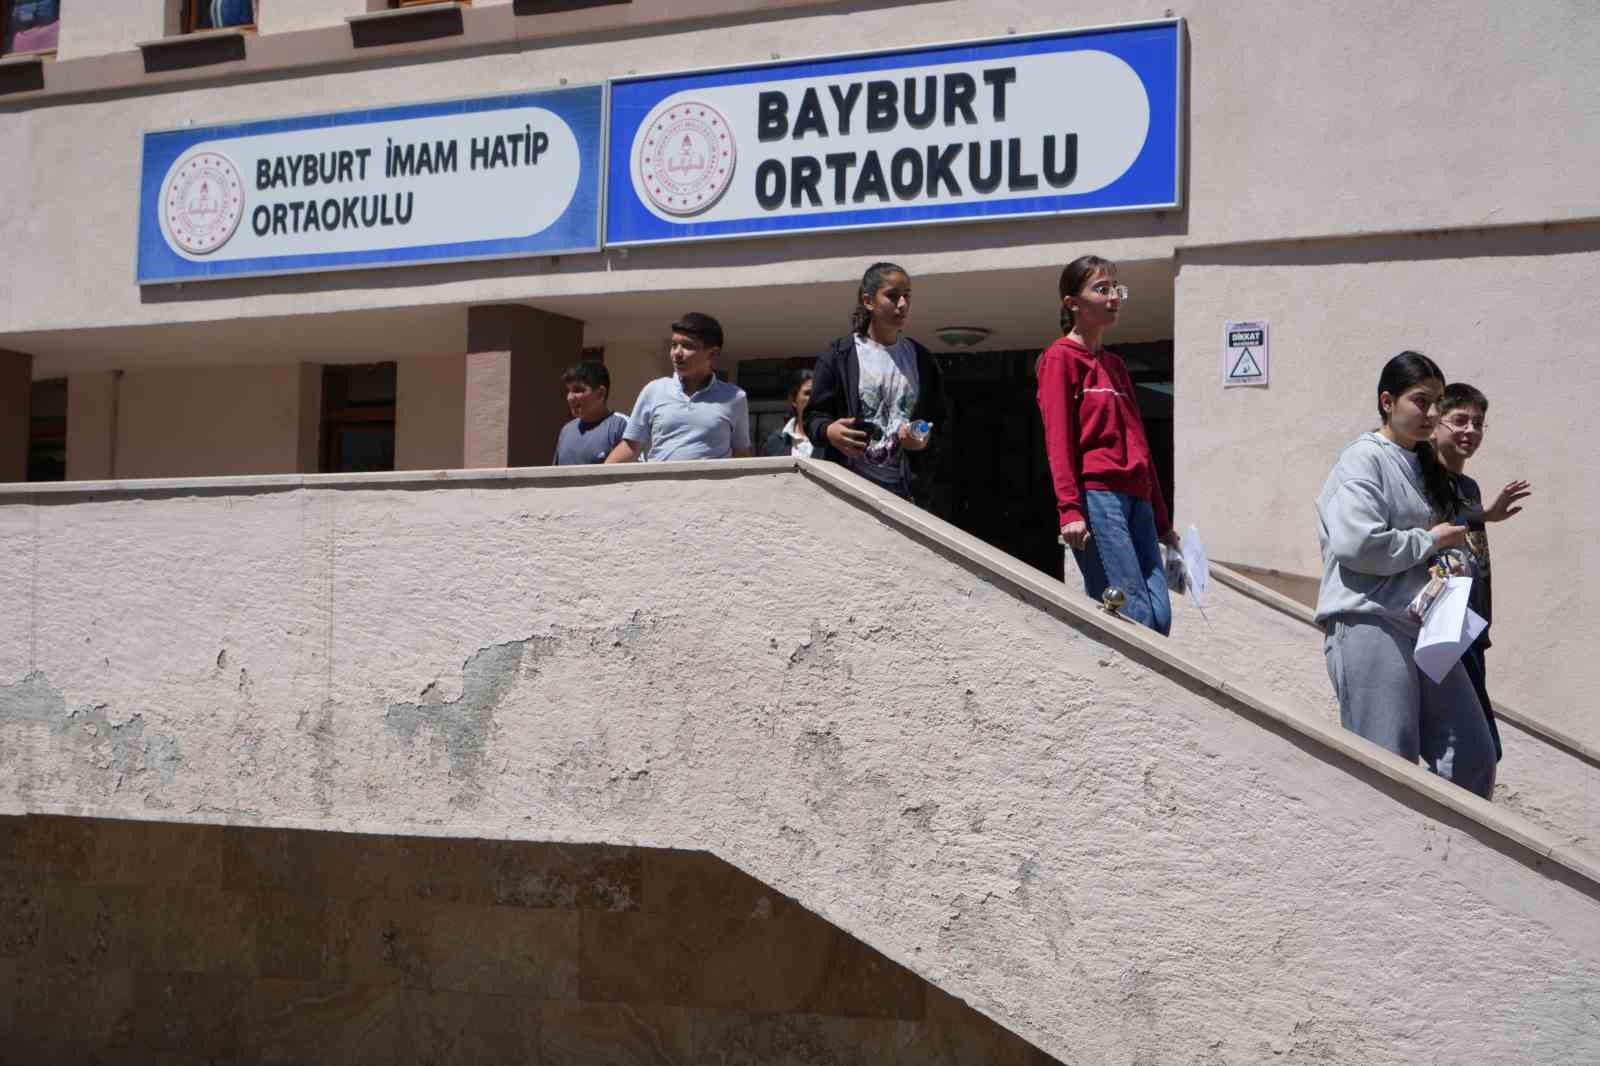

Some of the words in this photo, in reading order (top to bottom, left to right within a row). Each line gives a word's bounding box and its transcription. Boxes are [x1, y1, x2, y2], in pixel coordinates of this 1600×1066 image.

[757, 67, 1016, 142] BAYBURT
[256, 148, 372, 191] BAYBURT
[385, 137, 458, 178] İMAM
[470, 124, 549, 170] HATİP
[755, 133, 1078, 209] ORTAOKULU
[252, 191, 413, 237] ORTAOKULU
